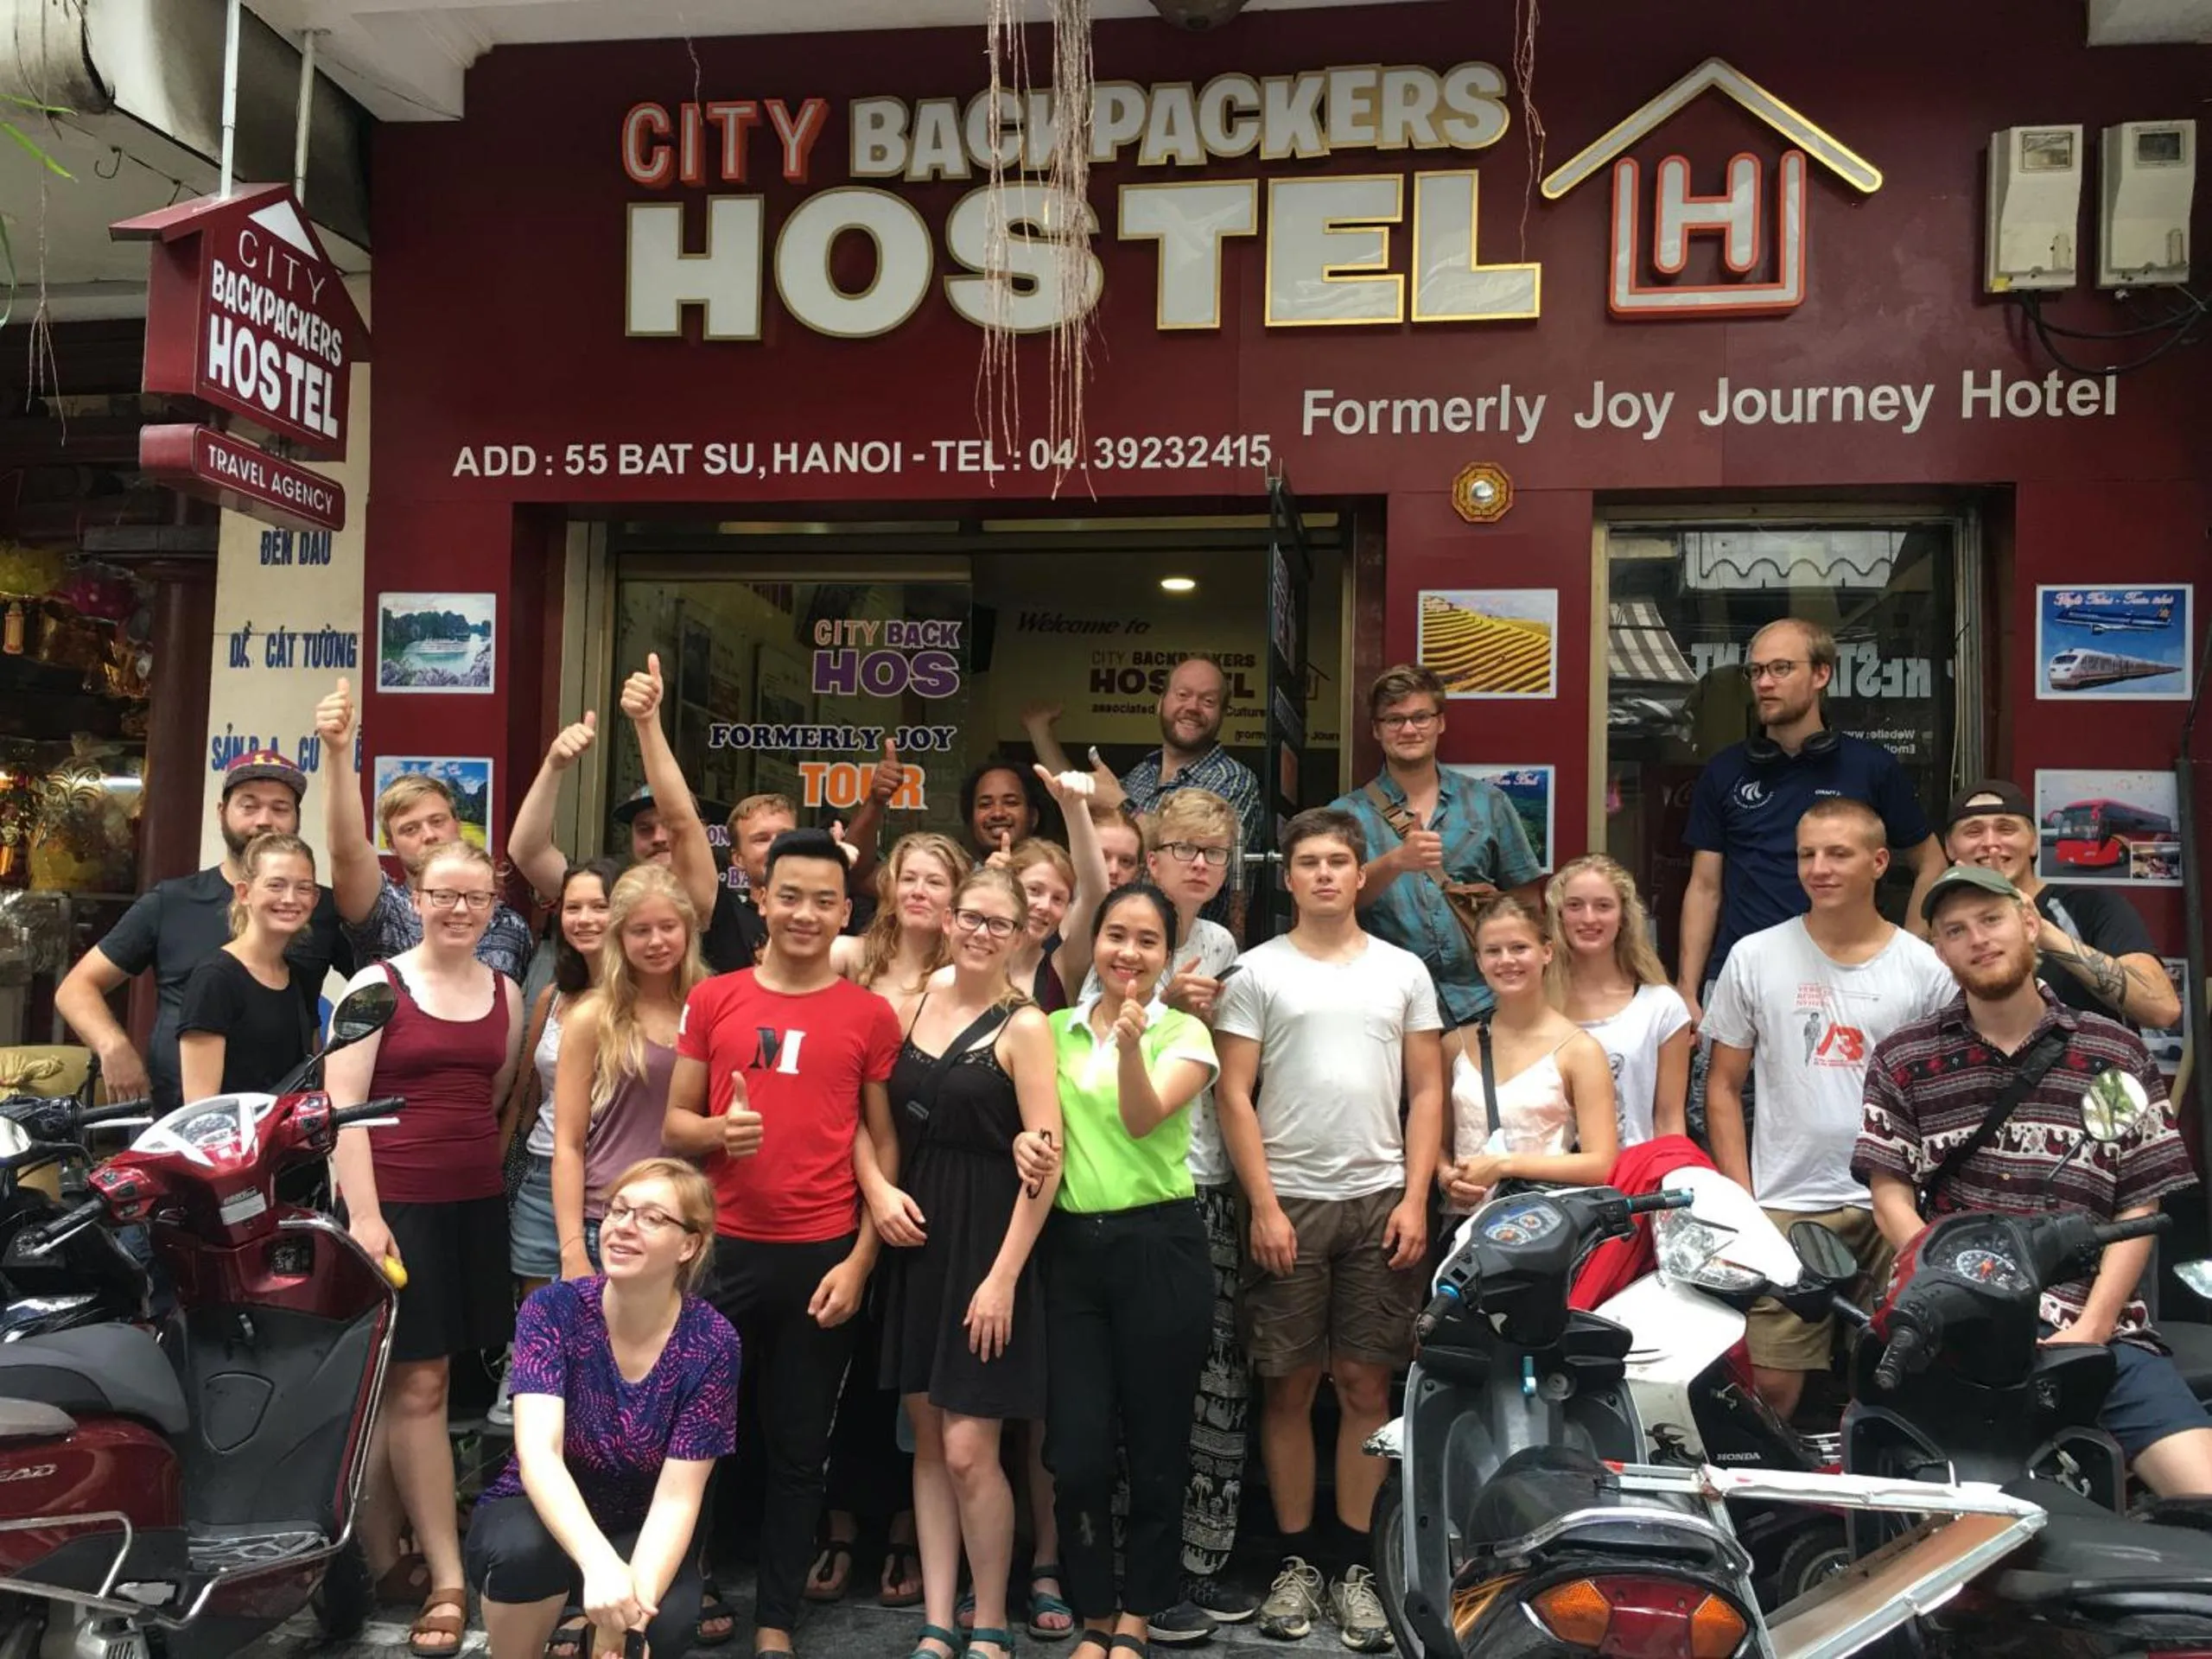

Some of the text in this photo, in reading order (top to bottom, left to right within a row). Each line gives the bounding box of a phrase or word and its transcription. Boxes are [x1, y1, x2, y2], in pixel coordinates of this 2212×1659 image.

[621, 61, 1510, 188] CITY BACKPACKERS
[238, 230, 326, 304] CITY
[625, 168, 1541, 341] HOSTEL
[212, 259, 342, 366] BACKPACKERS
[208, 314, 338, 439] HOSTEL
[1302, 366, 2118, 444] Formerly Joy Journey Hotel
[207, 444, 334, 515] TRAVEL AGENCY
[564, 444, 608, 474] 55
[619, 443, 693, 474] BAT
[265, 625, 296, 668] CÁT
[814, 620, 963, 650] CITY BACK
[1017, 611, 1152, 634] Welcome to
[812, 650, 960, 698] HOS
[1090, 652, 1126, 666] CITY
[709, 724, 957, 751] FORMERLY JOY
